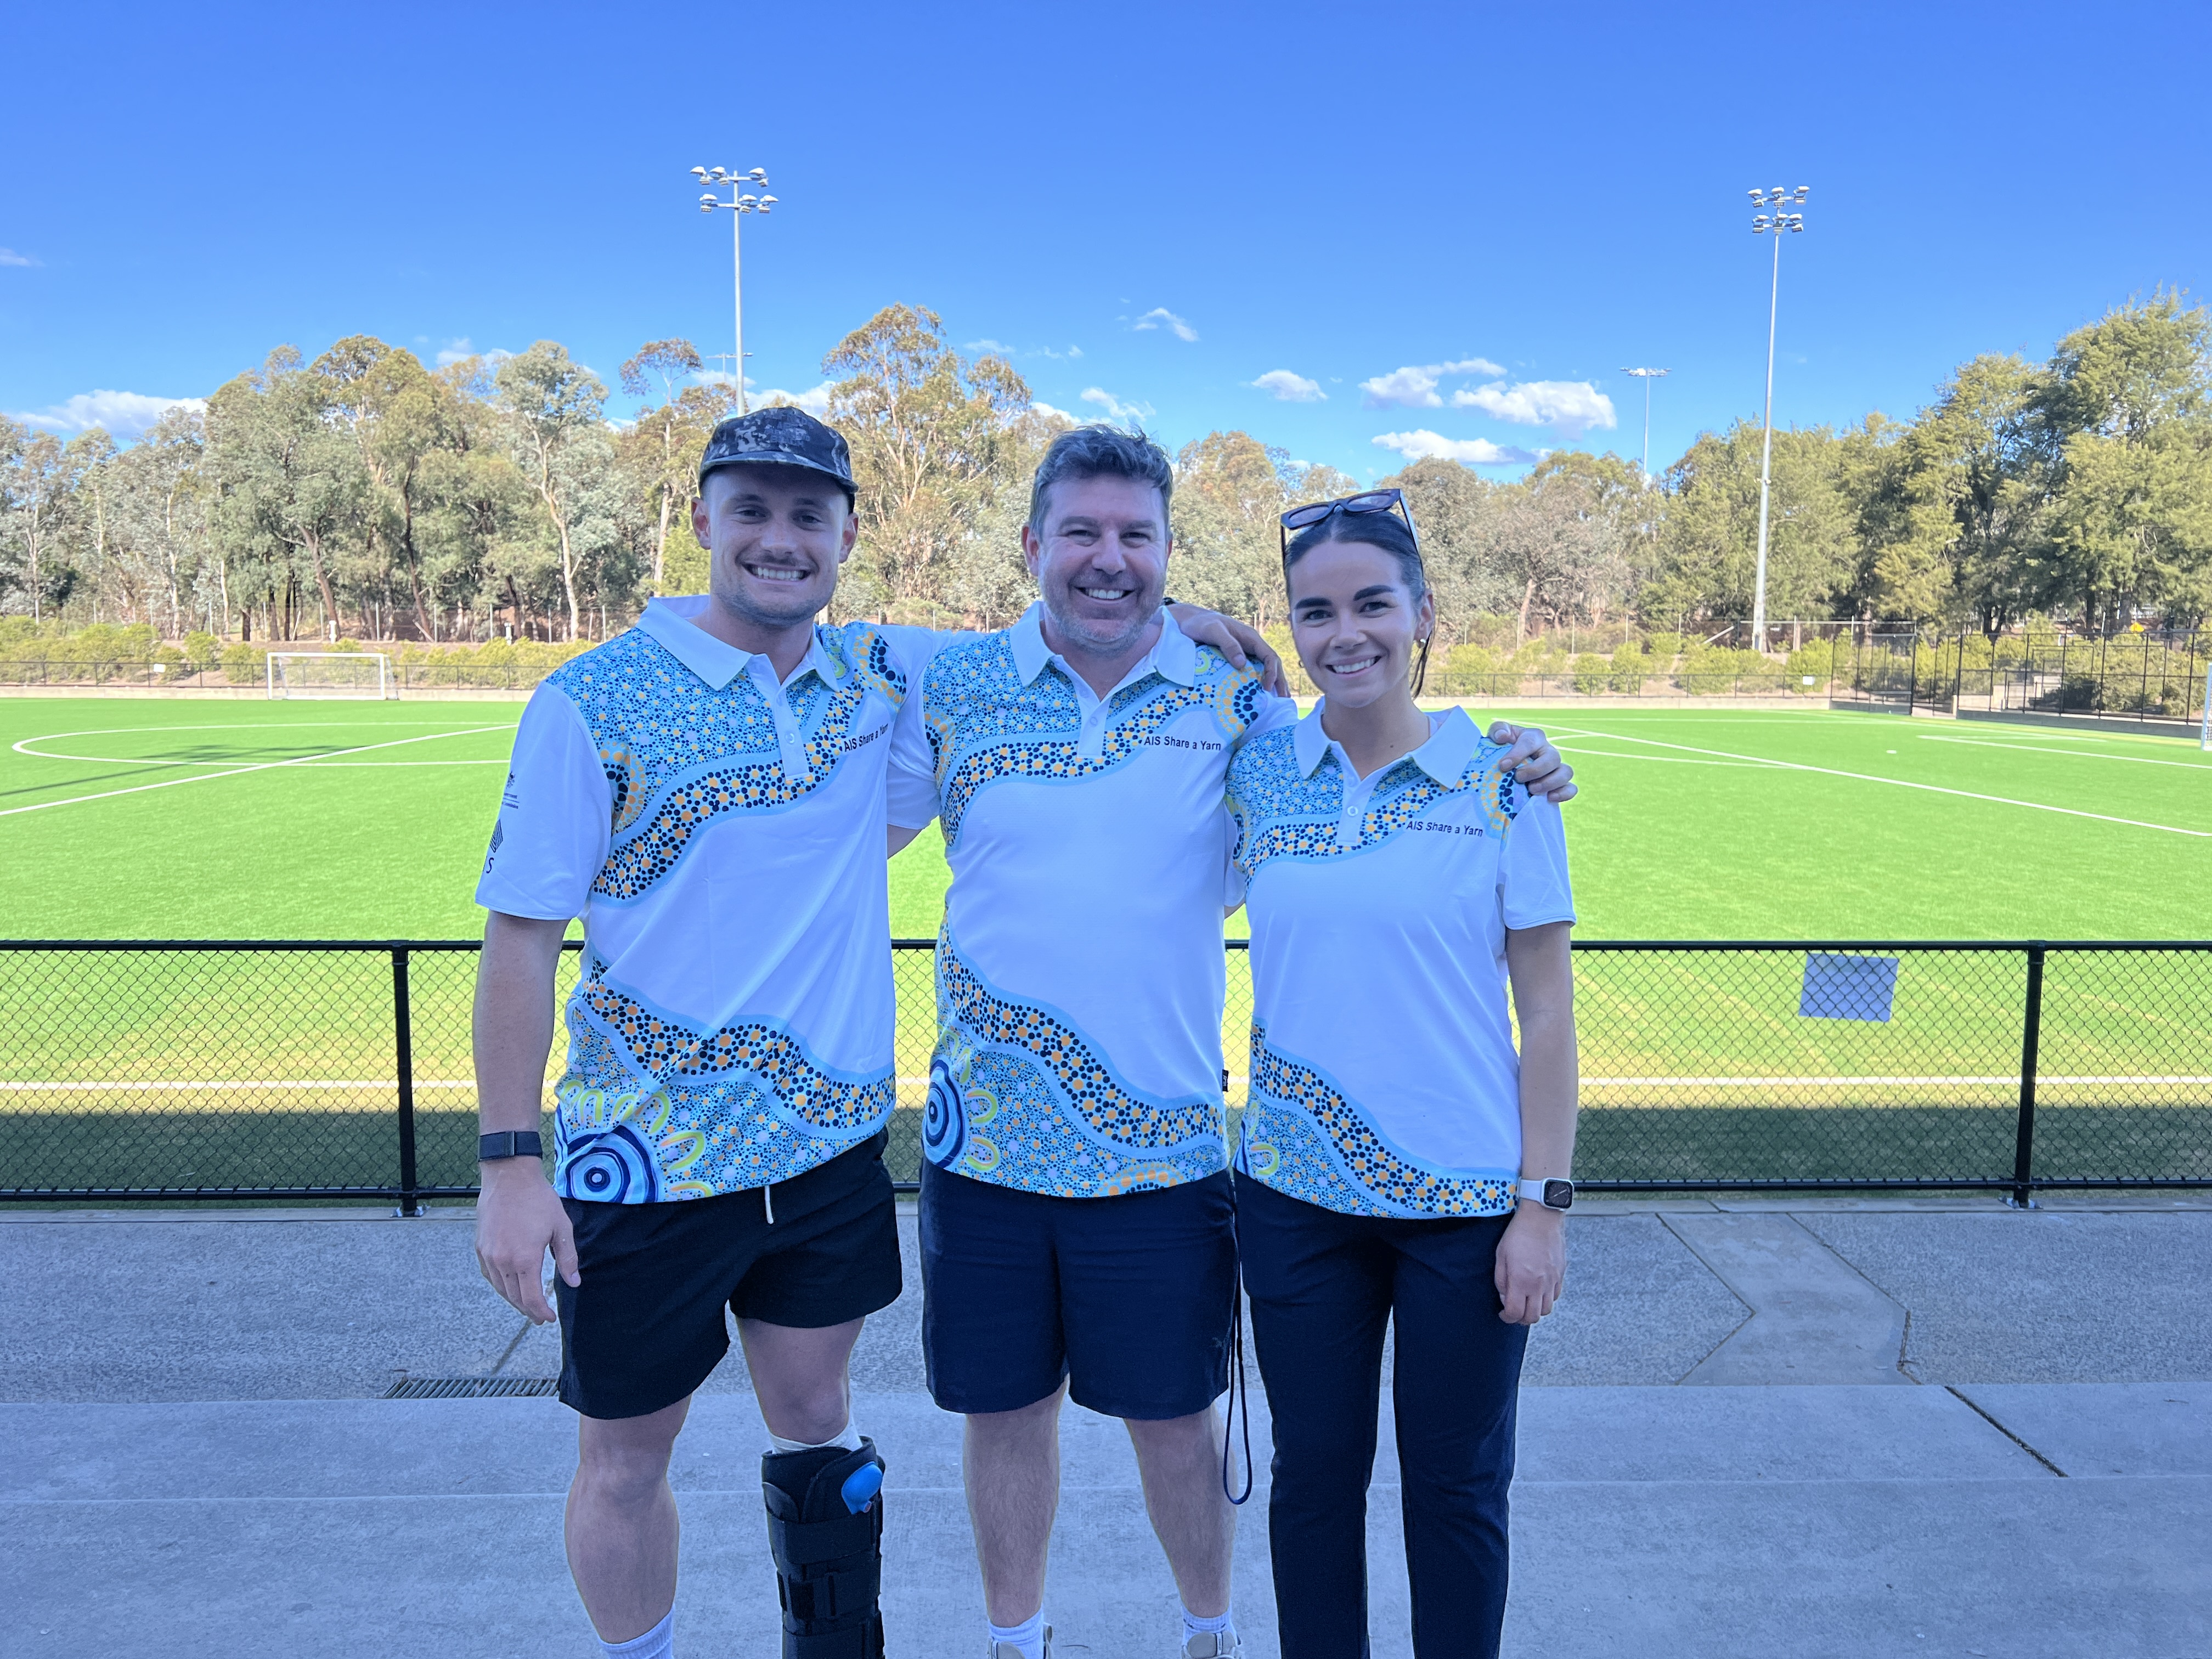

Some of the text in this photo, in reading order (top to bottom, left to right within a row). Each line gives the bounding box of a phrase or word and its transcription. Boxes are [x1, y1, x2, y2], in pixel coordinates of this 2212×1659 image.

[844, 738, 857, 752] AIS
[859, 732, 874, 747] Share
[875, 730, 878, 739] a
[1144, 736, 1161, 746] AIS
[1164, 736, 1189, 748] Share
[1200, 740, 1221, 751] Yarn
[1406, 821, 1423, 831] AIS
[1426, 822, 1452, 833] Share
[1464, 825, 1483, 837] Yarn
